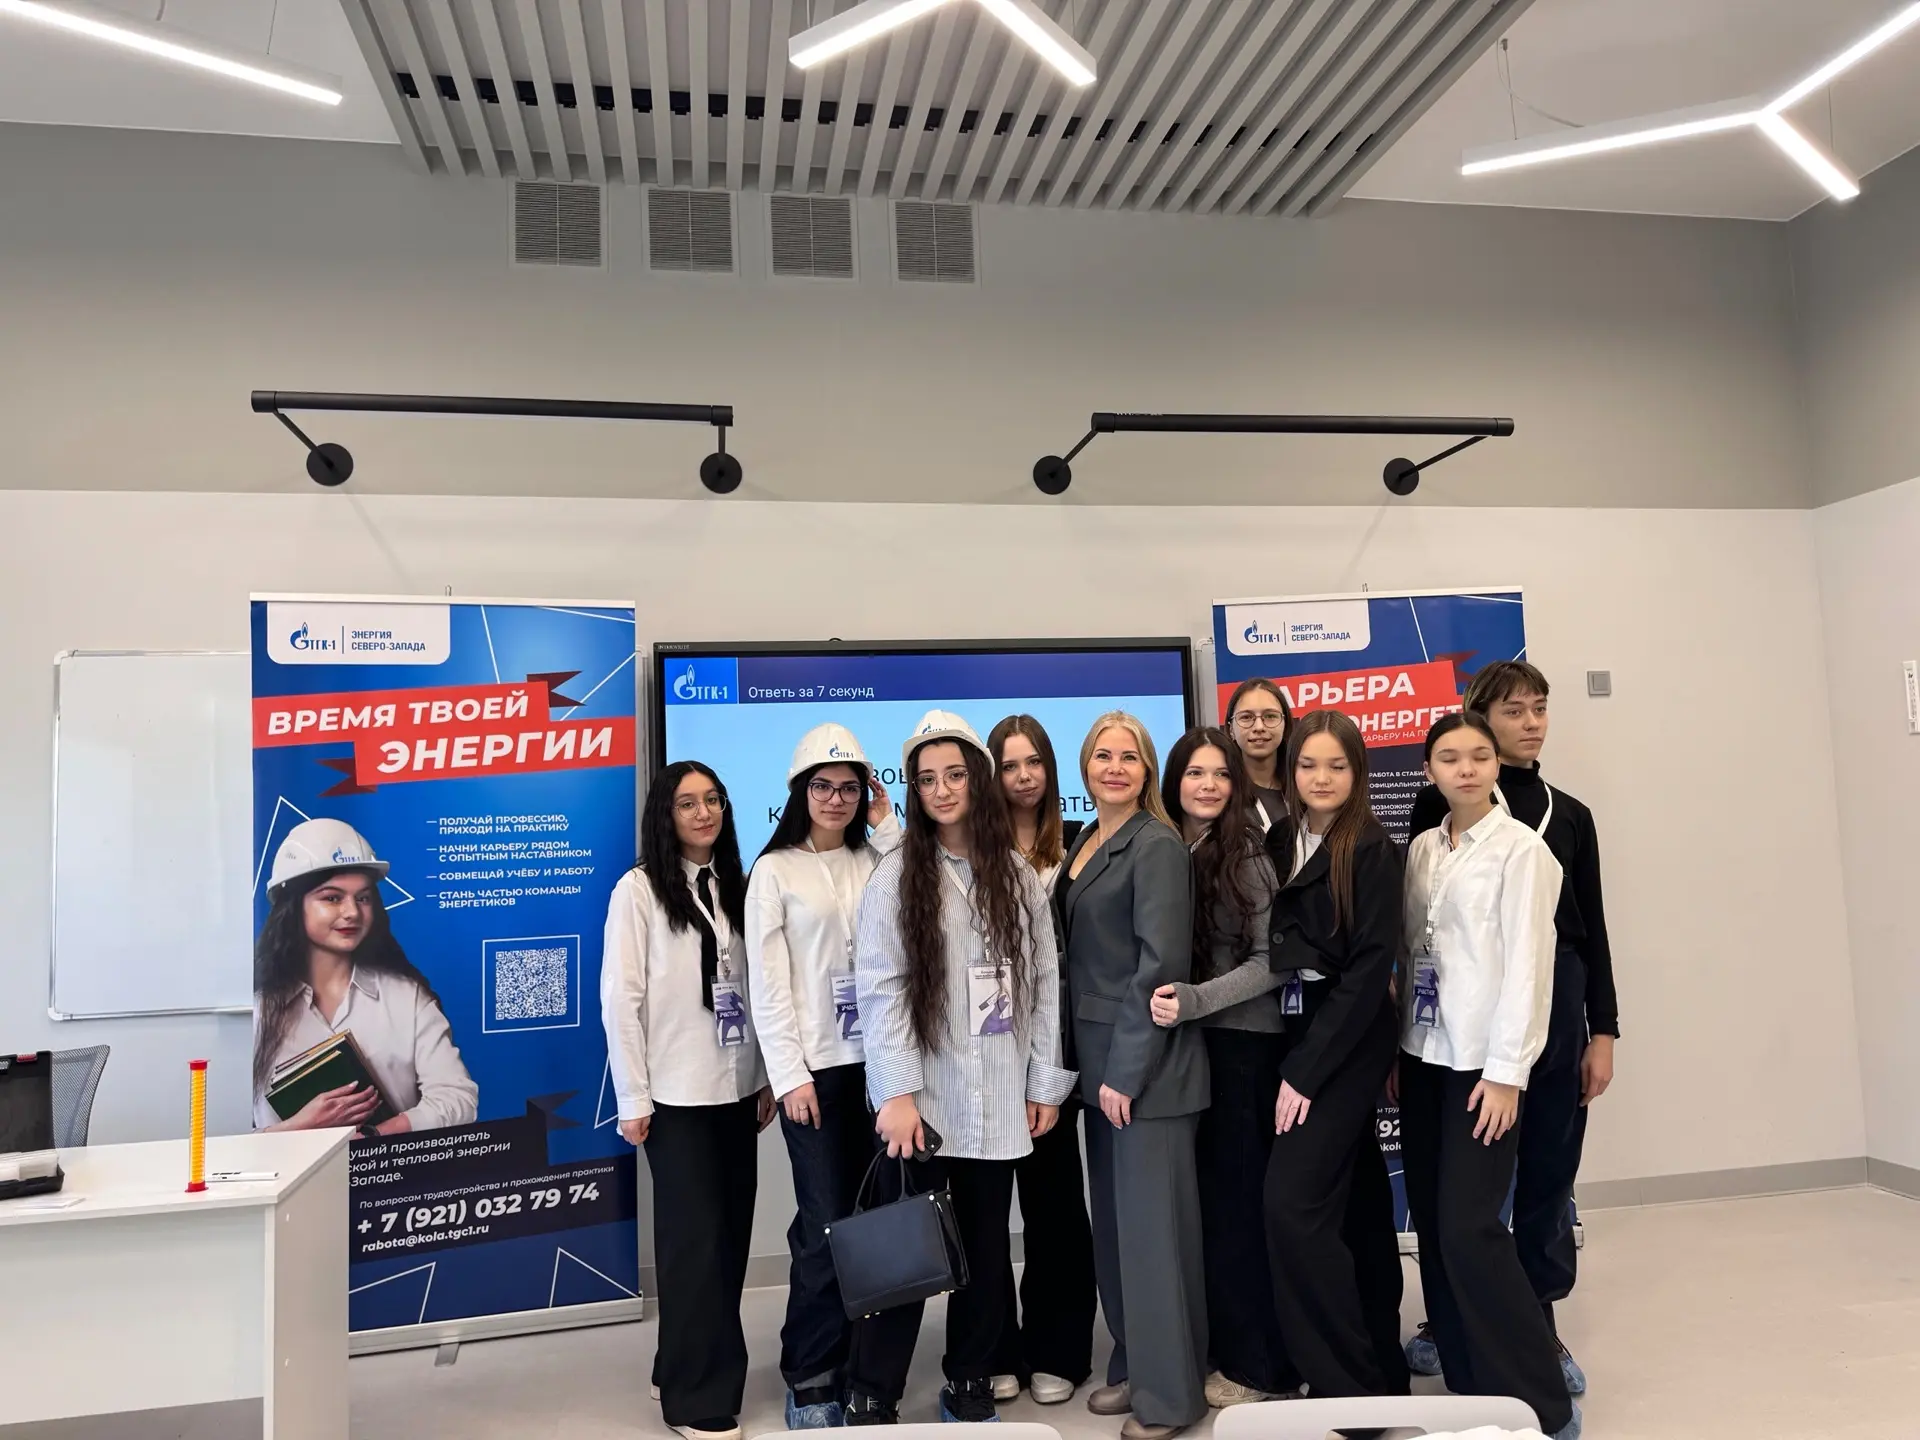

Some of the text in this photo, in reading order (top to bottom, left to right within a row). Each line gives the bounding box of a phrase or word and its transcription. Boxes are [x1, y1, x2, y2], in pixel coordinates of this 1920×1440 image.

[1291, 623, 1324, 632] ЭНЕРГИЯ
[351, 631, 392, 639] ЭНЕРГИЯ
[1291, 632, 1351, 642] СЕВЕРО-ЗАПАДА
[351, 641, 426, 652] СЕВЕРО-ЗАПАДА
[748, 685, 875, 699] Ответь за 7 секунд
[1279, 672, 1416, 709] АРЬЕРА
[267, 689, 529, 736] ВРЕМЯ ТВОЕЙ
[1348, 704, 1463, 733] НЕРГЕТ
[1403, 730, 1416, 739] НА
[376, 726, 614, 774] ЭНЕРГИИ
[1059, 796, 1095, 812] ать
[439, 814, 568, 826] ПОЛУЧАЙ ПРОФЕССИЮ,
[439, 823, 569, 835] ПРИХОДИ НА ПРАКТИКУ
[439, 841, 570, 853] НАЧНИ КАРЬЕРУ РЯДОМ
[439, 849, 592, 862] С ОПЫТНЫМ НАСТАВНИКОМ
[439, 867, 595, 881] СОВМЕЩАЙ УЧЁБУ И РАБОТУ
[439, 886, 581, 900] СТАНЬ ЧАСТЬЮ КОМАНДЫ
[439, 898, 516, 909] ЭНЕРГЕТИКОВ
[1375, 1119, 1400, 1137] (92
[350, 1130, 490, 1161] ущий производитель
[349, 1141, 510, 1173] кой и тепловой энергии
[349, 1172, 404, 1187] Западе.
[359, 1201, 373, 1209] По
[375, 1194, 421, 1208] вопросам
[424, 1182, 500, 1201] трудоустройства
[510, 1172, 571, 1188] прохождения
[572, 1165, 614, 1179] практики
[357, 1182, 600, 1234] + 7 (921) 032 79 74
[362, 1224, 490, 1253] rabota@kola.tgc1.ru
